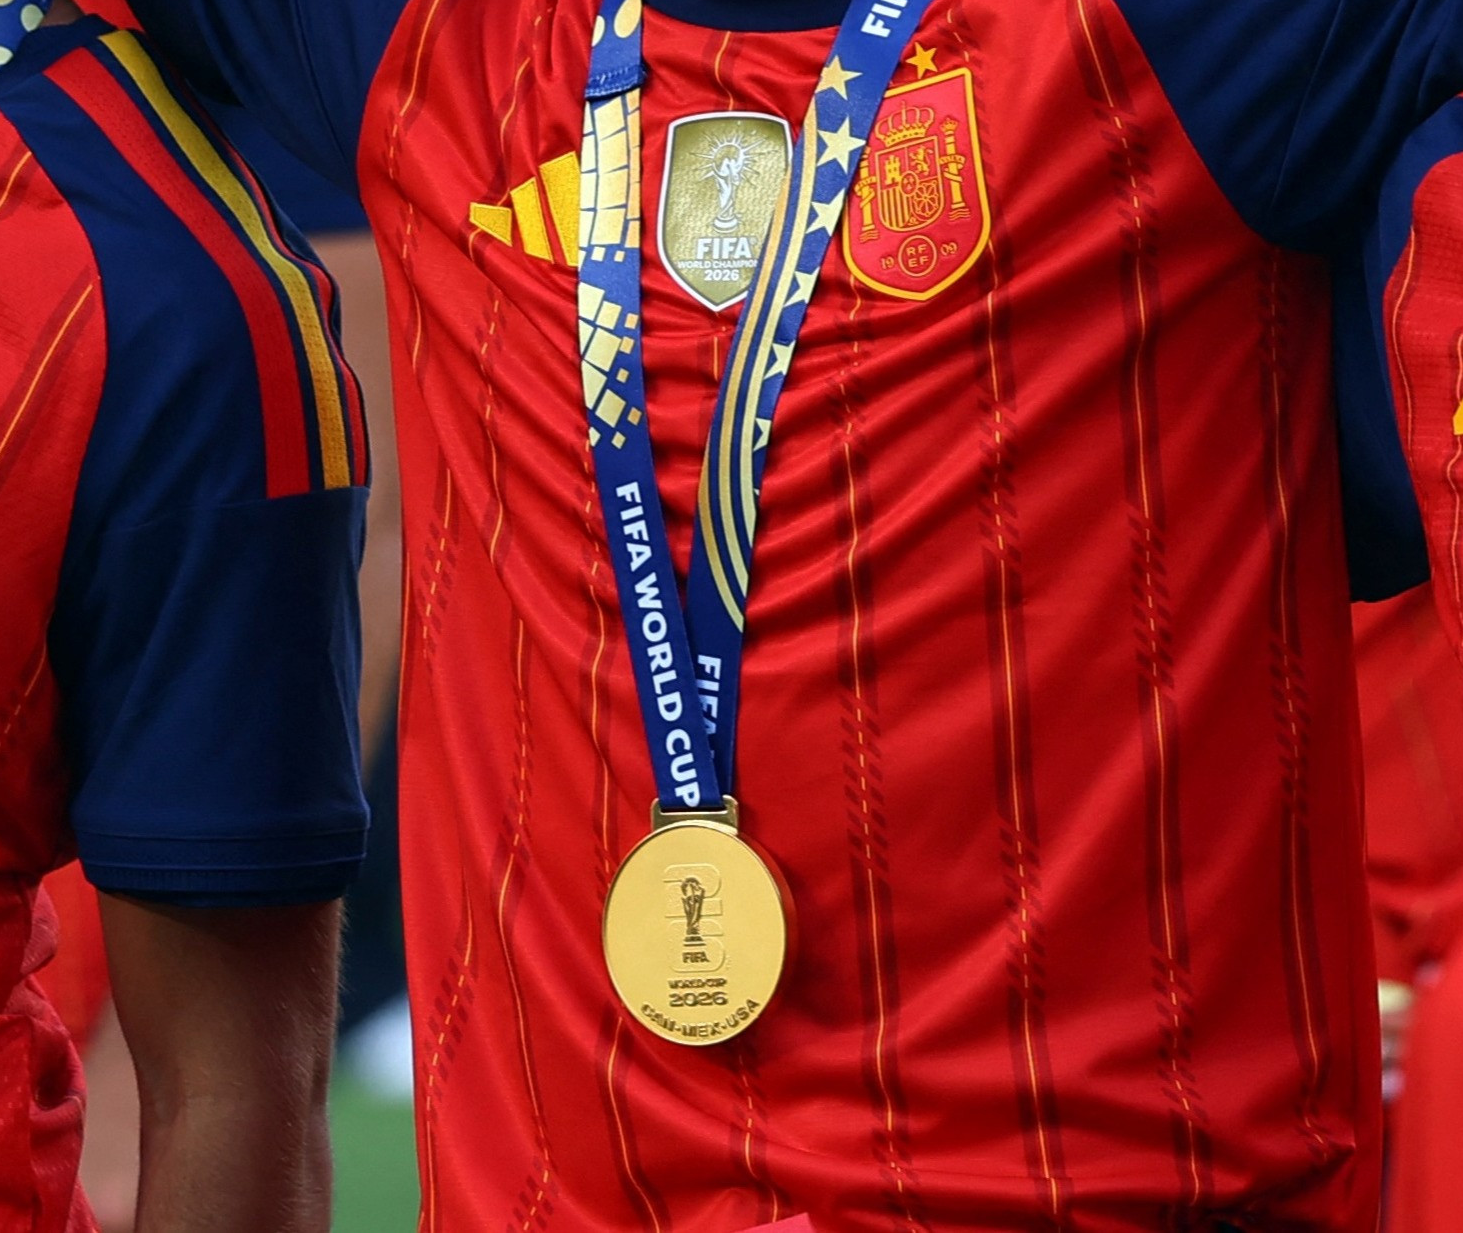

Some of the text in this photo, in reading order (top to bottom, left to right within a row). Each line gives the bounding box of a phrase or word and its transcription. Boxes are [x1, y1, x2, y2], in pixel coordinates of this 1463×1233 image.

[677, 260, 711, 269] WORLD
[704, 269, 739, 281] 2026
[616, 481, 700, 807] FIFA WORLD CUP
[682, 951, 710, 963] FIFA
[669, 991, 728, 1007] 2026
